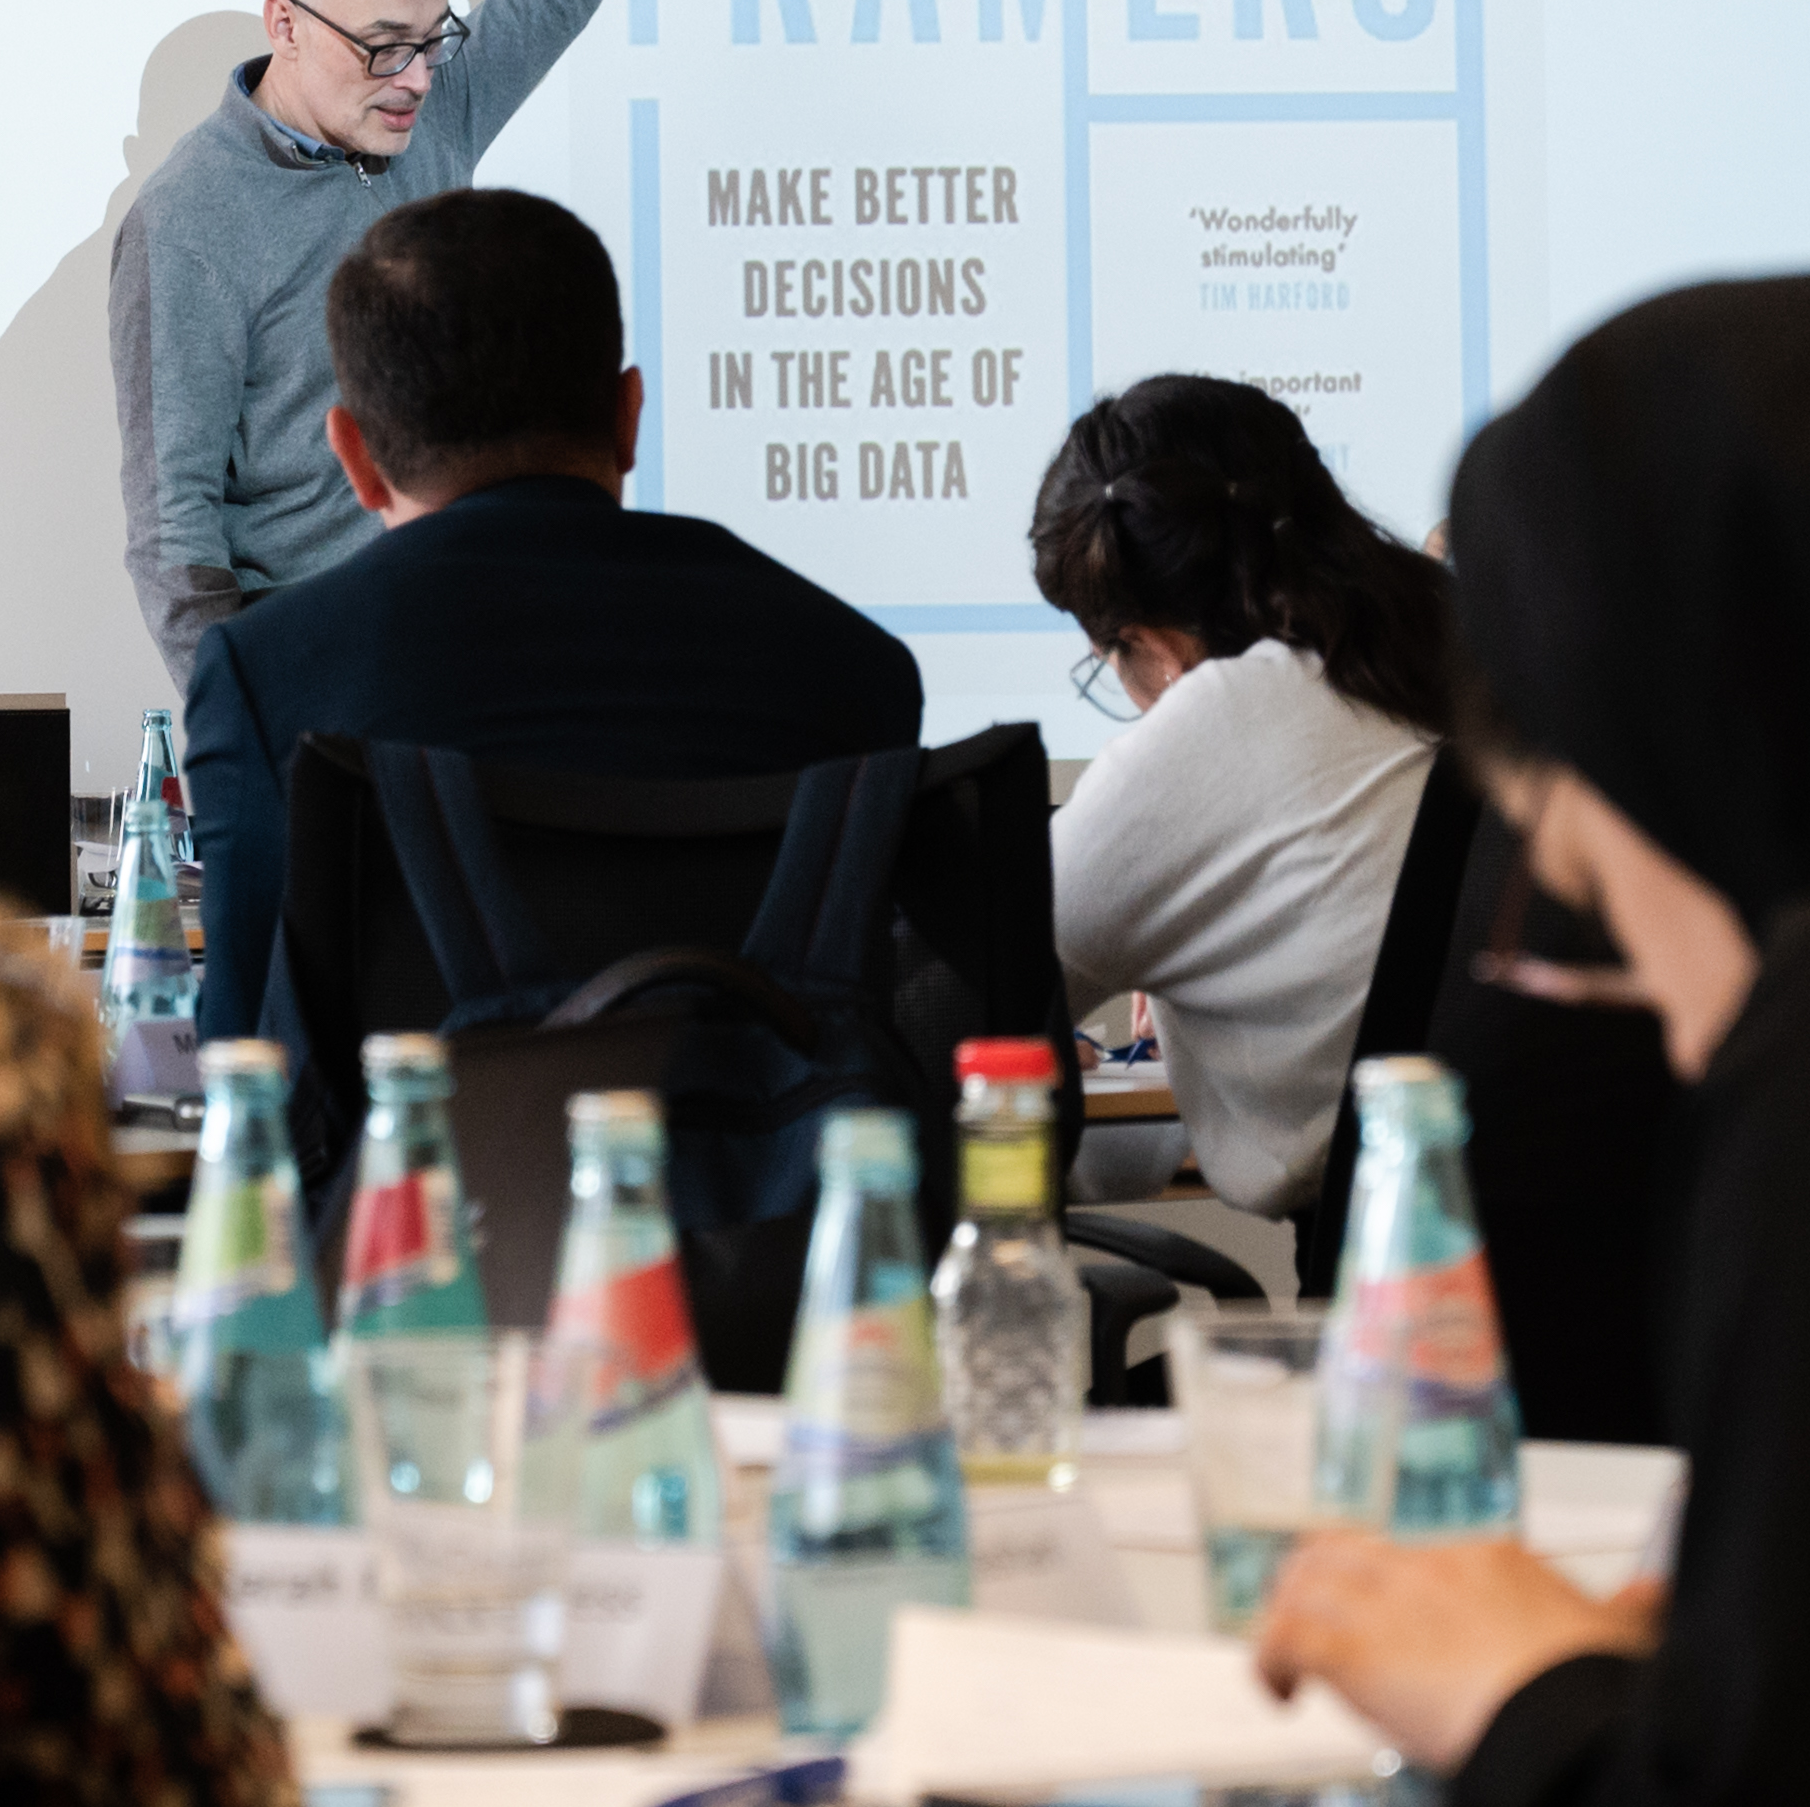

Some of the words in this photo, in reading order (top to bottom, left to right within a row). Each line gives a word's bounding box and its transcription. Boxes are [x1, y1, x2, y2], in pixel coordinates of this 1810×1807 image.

[708, 168, 832, 226] MAKE
[855, 166, 1018, 225] BETTER
[1189, 205, 1357, 238] ‘Wonderfully
[1201, 242, 1345, 273] stimulating’
[743, 258, 986, 318] DECISIONS
[1200, 283, 1237, 309] TIM
[1247, 281, 1349, 310] HARFORD
[709, 352, 752, 409] IN
[770, 351, 851, 409] THE
[870, 349, 953, 408] AGE
[972, 348, 1023, 407] OF
[766, 442, 838, 501] BIG
[859, 441, 968, 500] DATA
